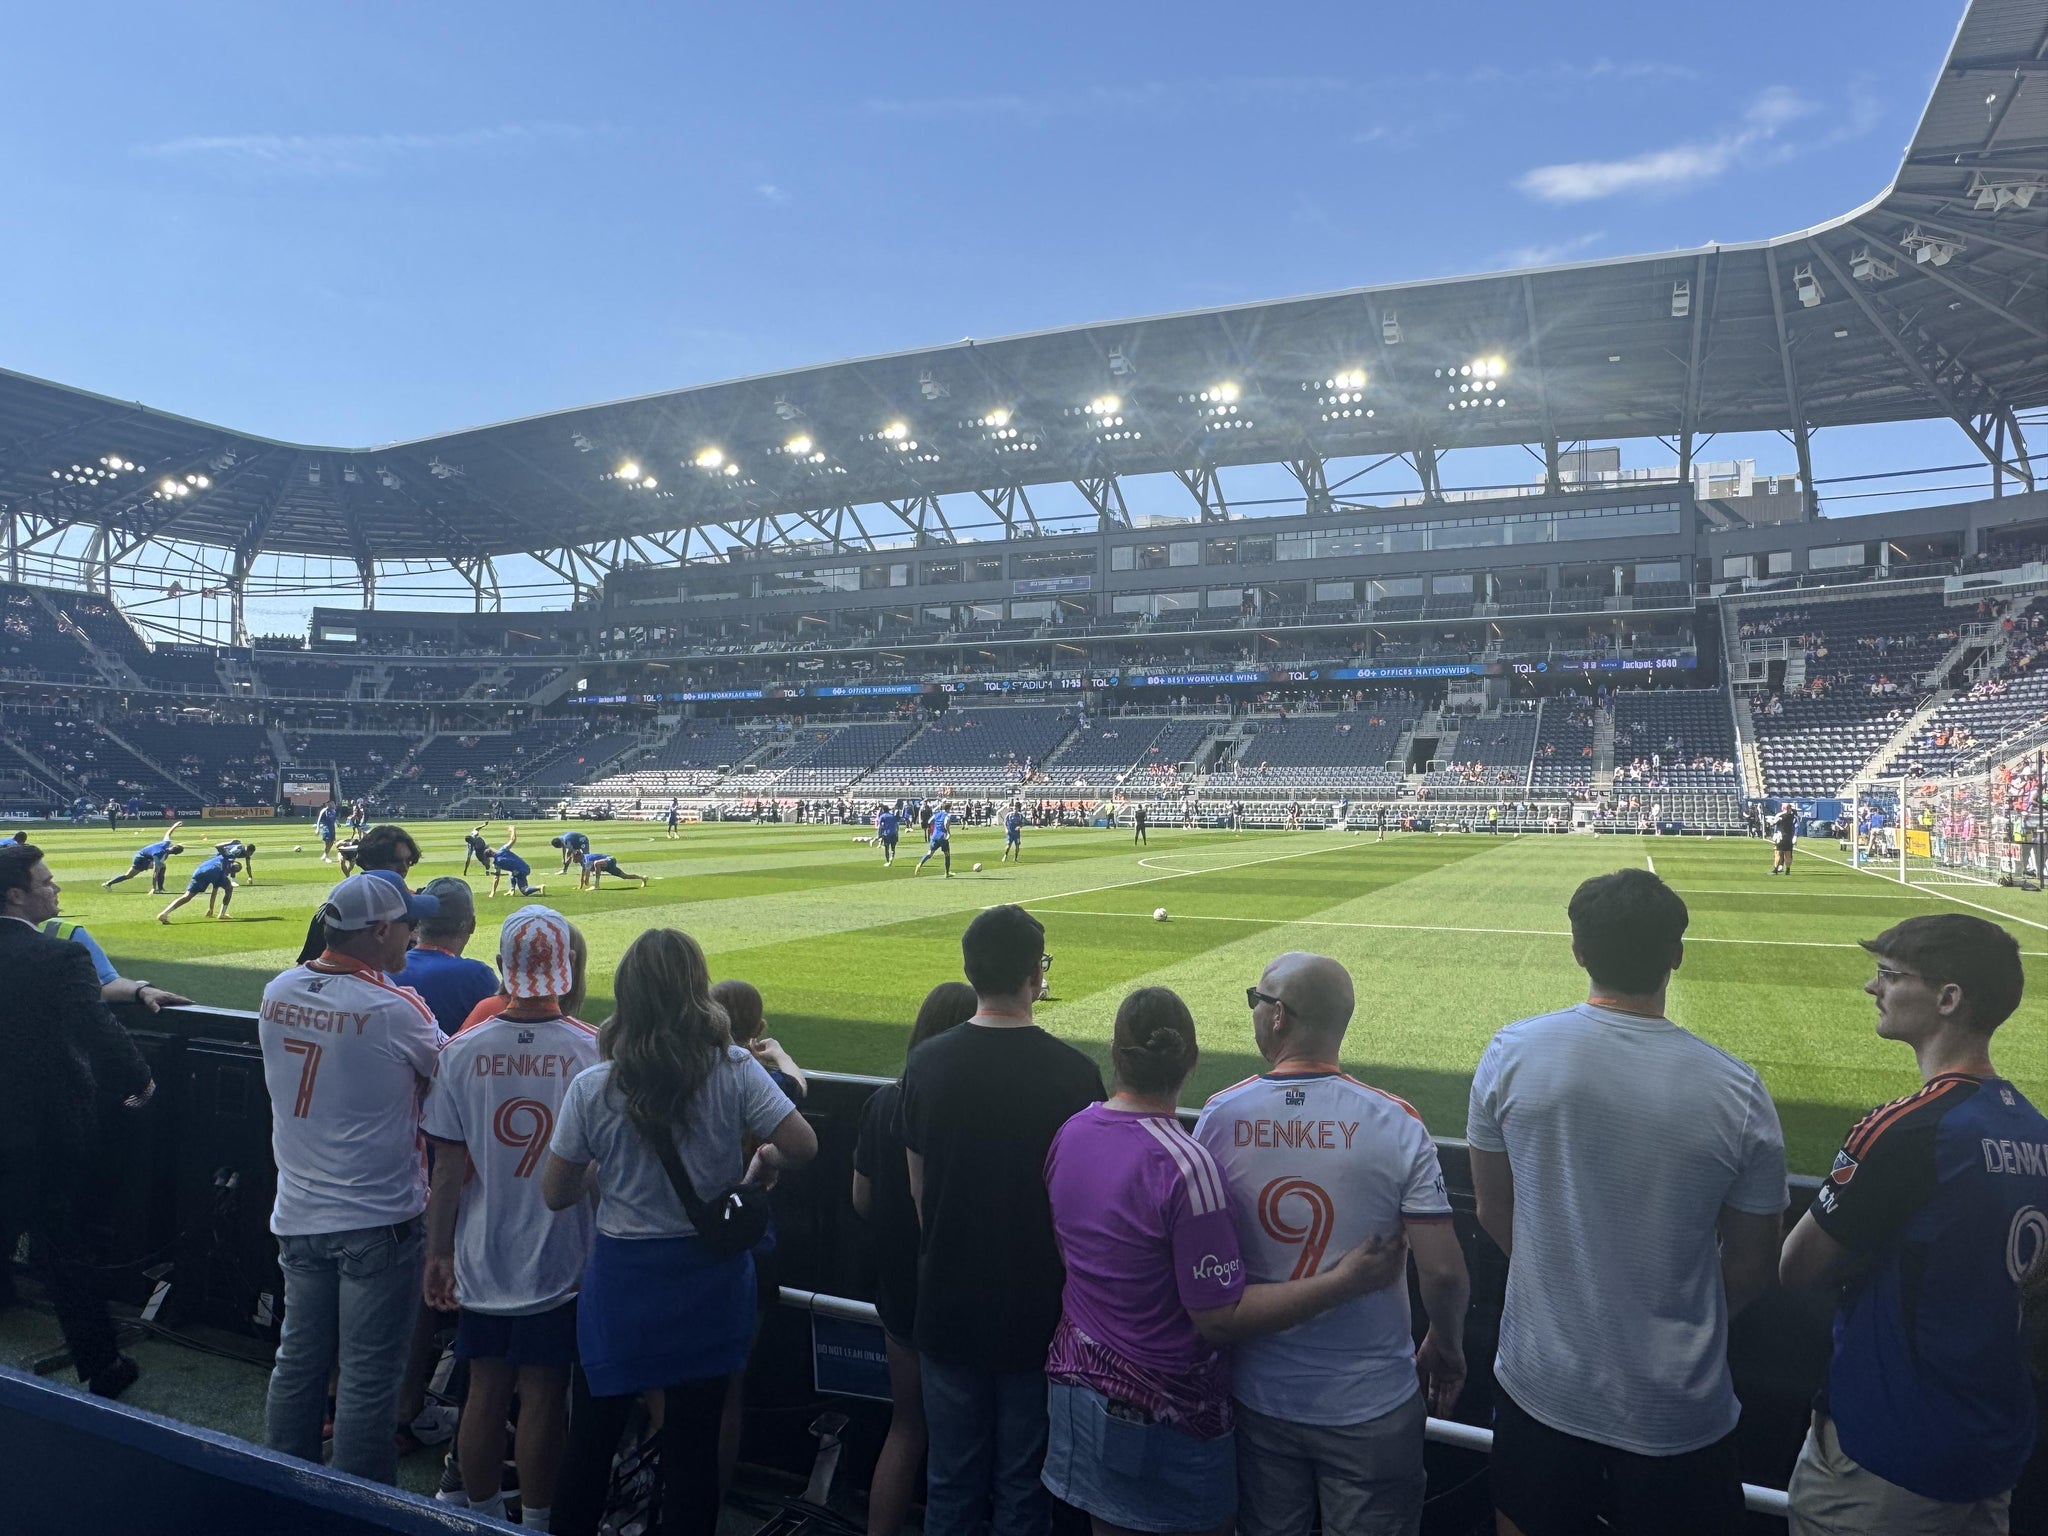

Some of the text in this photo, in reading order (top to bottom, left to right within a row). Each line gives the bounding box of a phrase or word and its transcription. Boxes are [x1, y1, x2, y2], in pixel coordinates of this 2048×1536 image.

[1380, 669, 1412, 677] OFFICES
[1415, 667, 1470, 676] NATIONWIDE
[1513, 664, 1536, 673] TQL
[1091, 678, 1109, 687] TQL
[1147, 673, 1258, 685] 80+ BEST WORKPLACE WINS
[1289, 672, 1308, 681] TQL
[940, 684, 957, 692] TQL
[984, 682, 1001, 691] TQL
[643, 694, 656, 702] TQL
[783, 689, 798, 698] TQL
[476, 1054, 577, 1078] DENKEY
[284, 1037, 323, 1119] 7
[493, 1096, 553, 1178] 9
[1234, 1120, 1361, 1149] DENKEY
[1982, 1138, 2048, 1177] DENK
[1258, 1176, 1335, 1282] 9
[1193, 1254, 1239, 1286] Kroger
[828, 1345, 843, 1357] NOT
[844, 1347, 863, 1359] LEAN
[864, 1350, 875, 1361] ON
